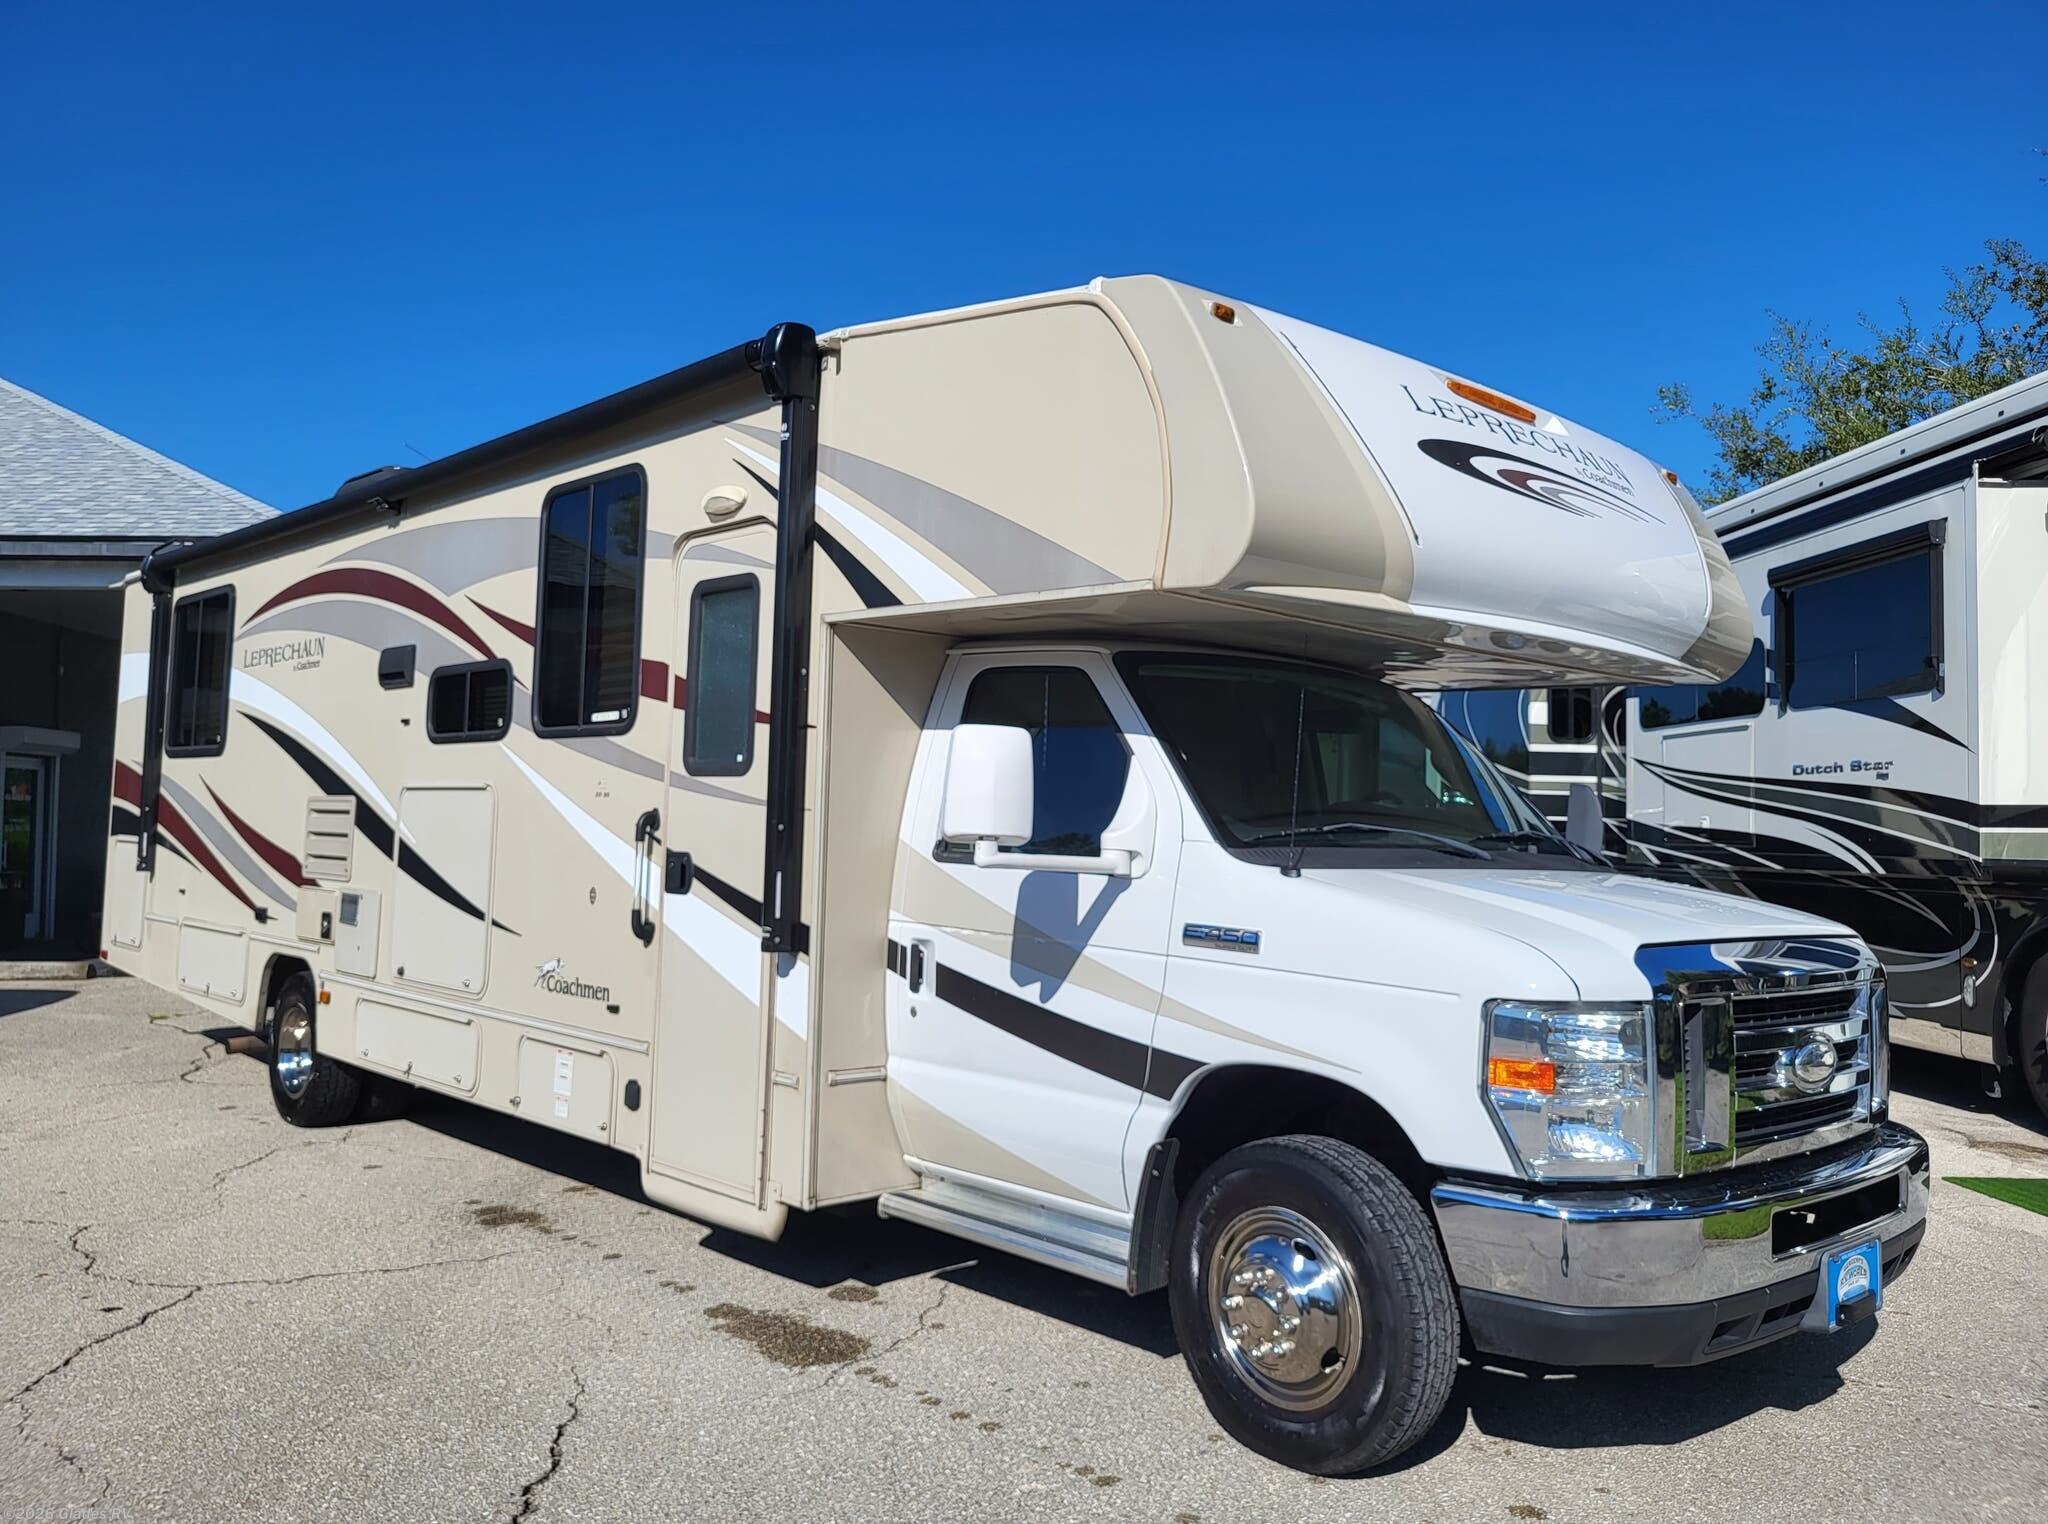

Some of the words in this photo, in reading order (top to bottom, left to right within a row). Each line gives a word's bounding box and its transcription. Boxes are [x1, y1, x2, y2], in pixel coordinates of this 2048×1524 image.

[1400, 384, 1635, 490] LEPRECHAUN
[243, 636, 326, 669] LEPRECHAUN
[1792, 762, 1844, 776] Dutch
[1850, 760, 1894, 772] Star
[546, 974, 610, 1002] Coachmen
